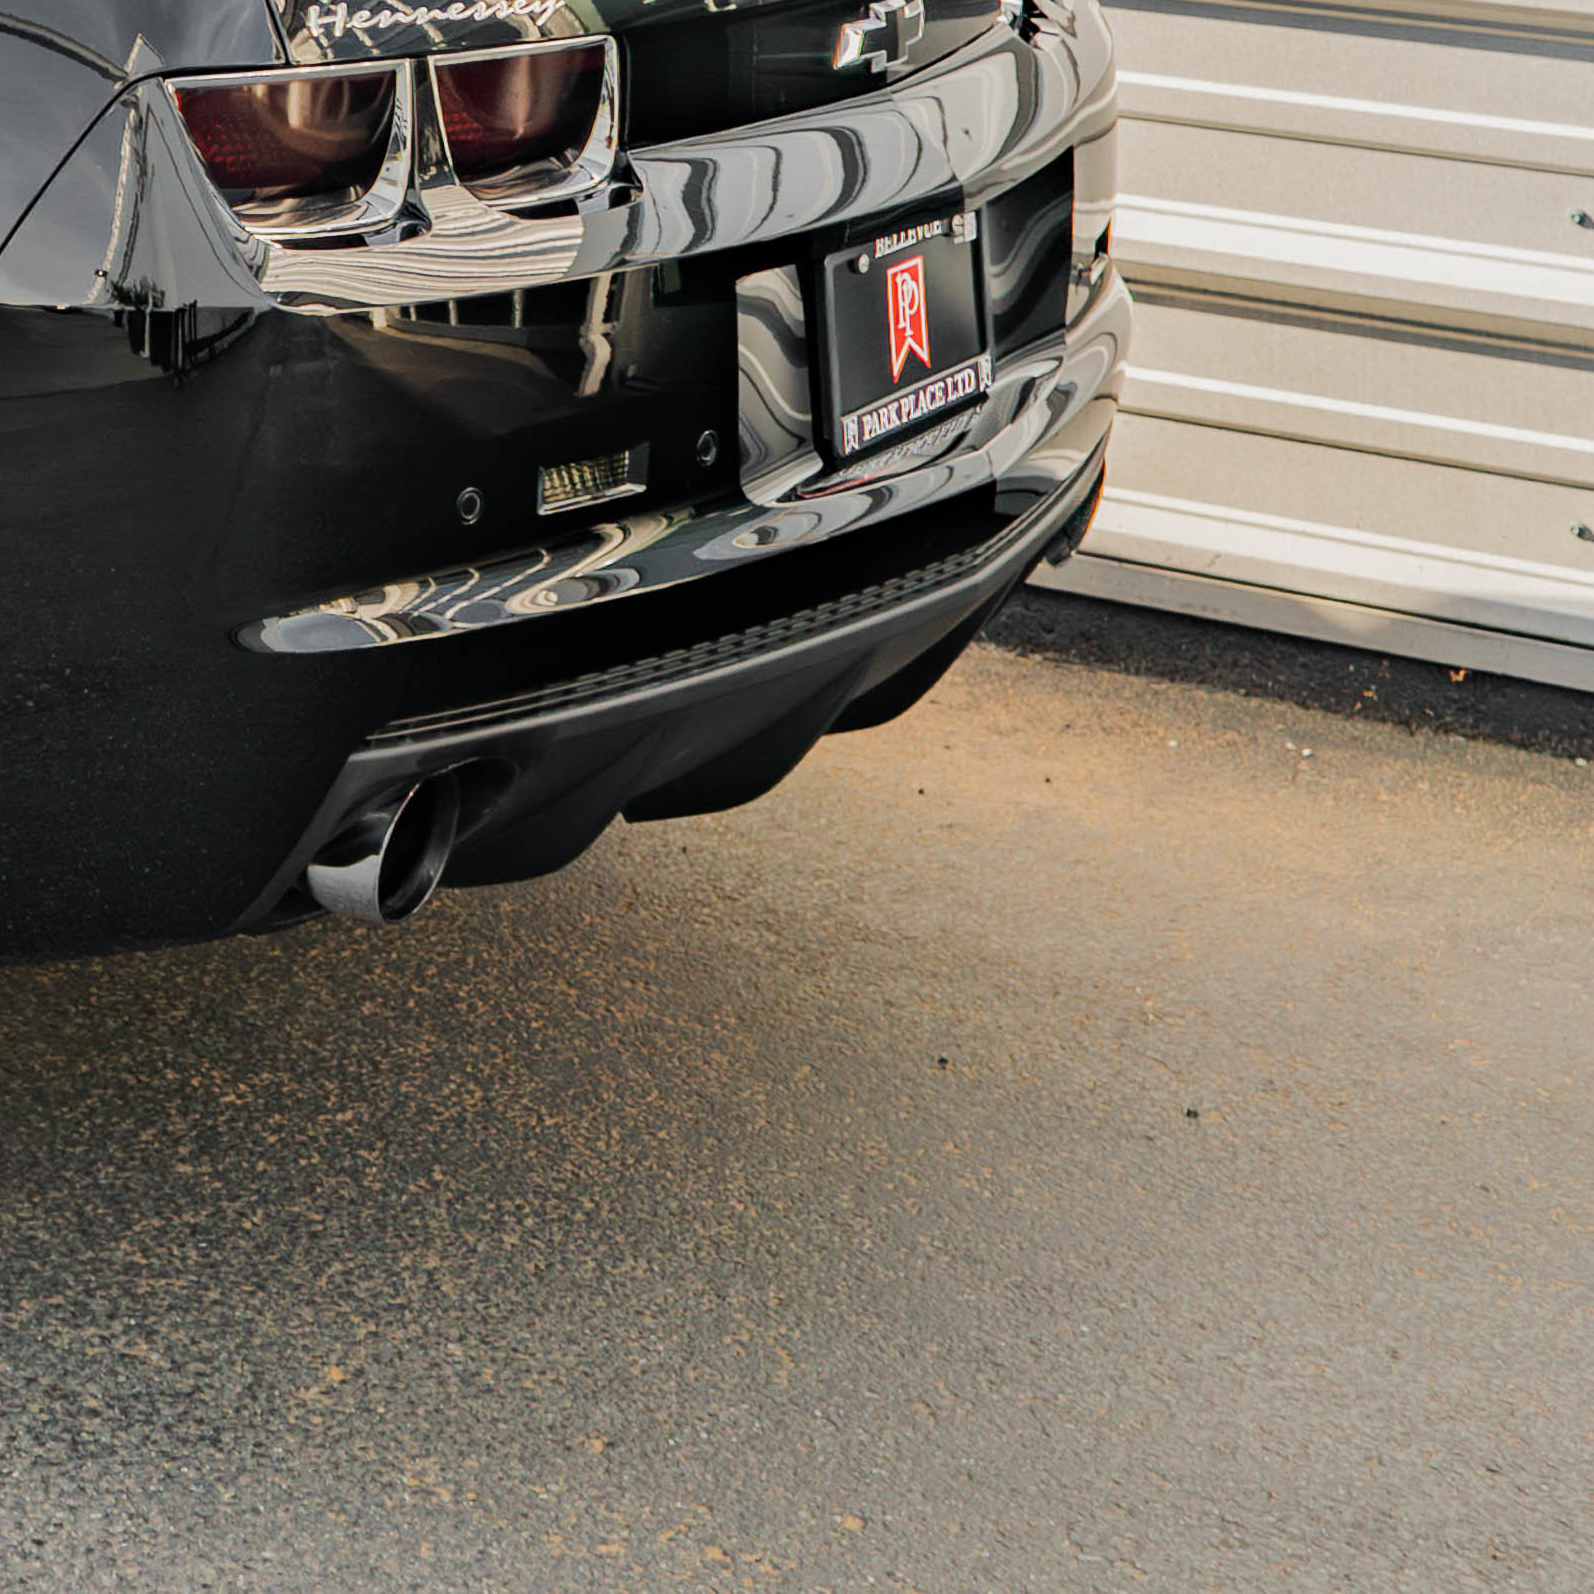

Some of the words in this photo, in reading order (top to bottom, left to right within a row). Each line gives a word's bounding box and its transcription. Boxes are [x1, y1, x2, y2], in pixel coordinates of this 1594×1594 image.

[862, 402, 902, 441] PARK
[899, 380, 946, 423] PLACE
[946, 368, 977, 401] LTD
